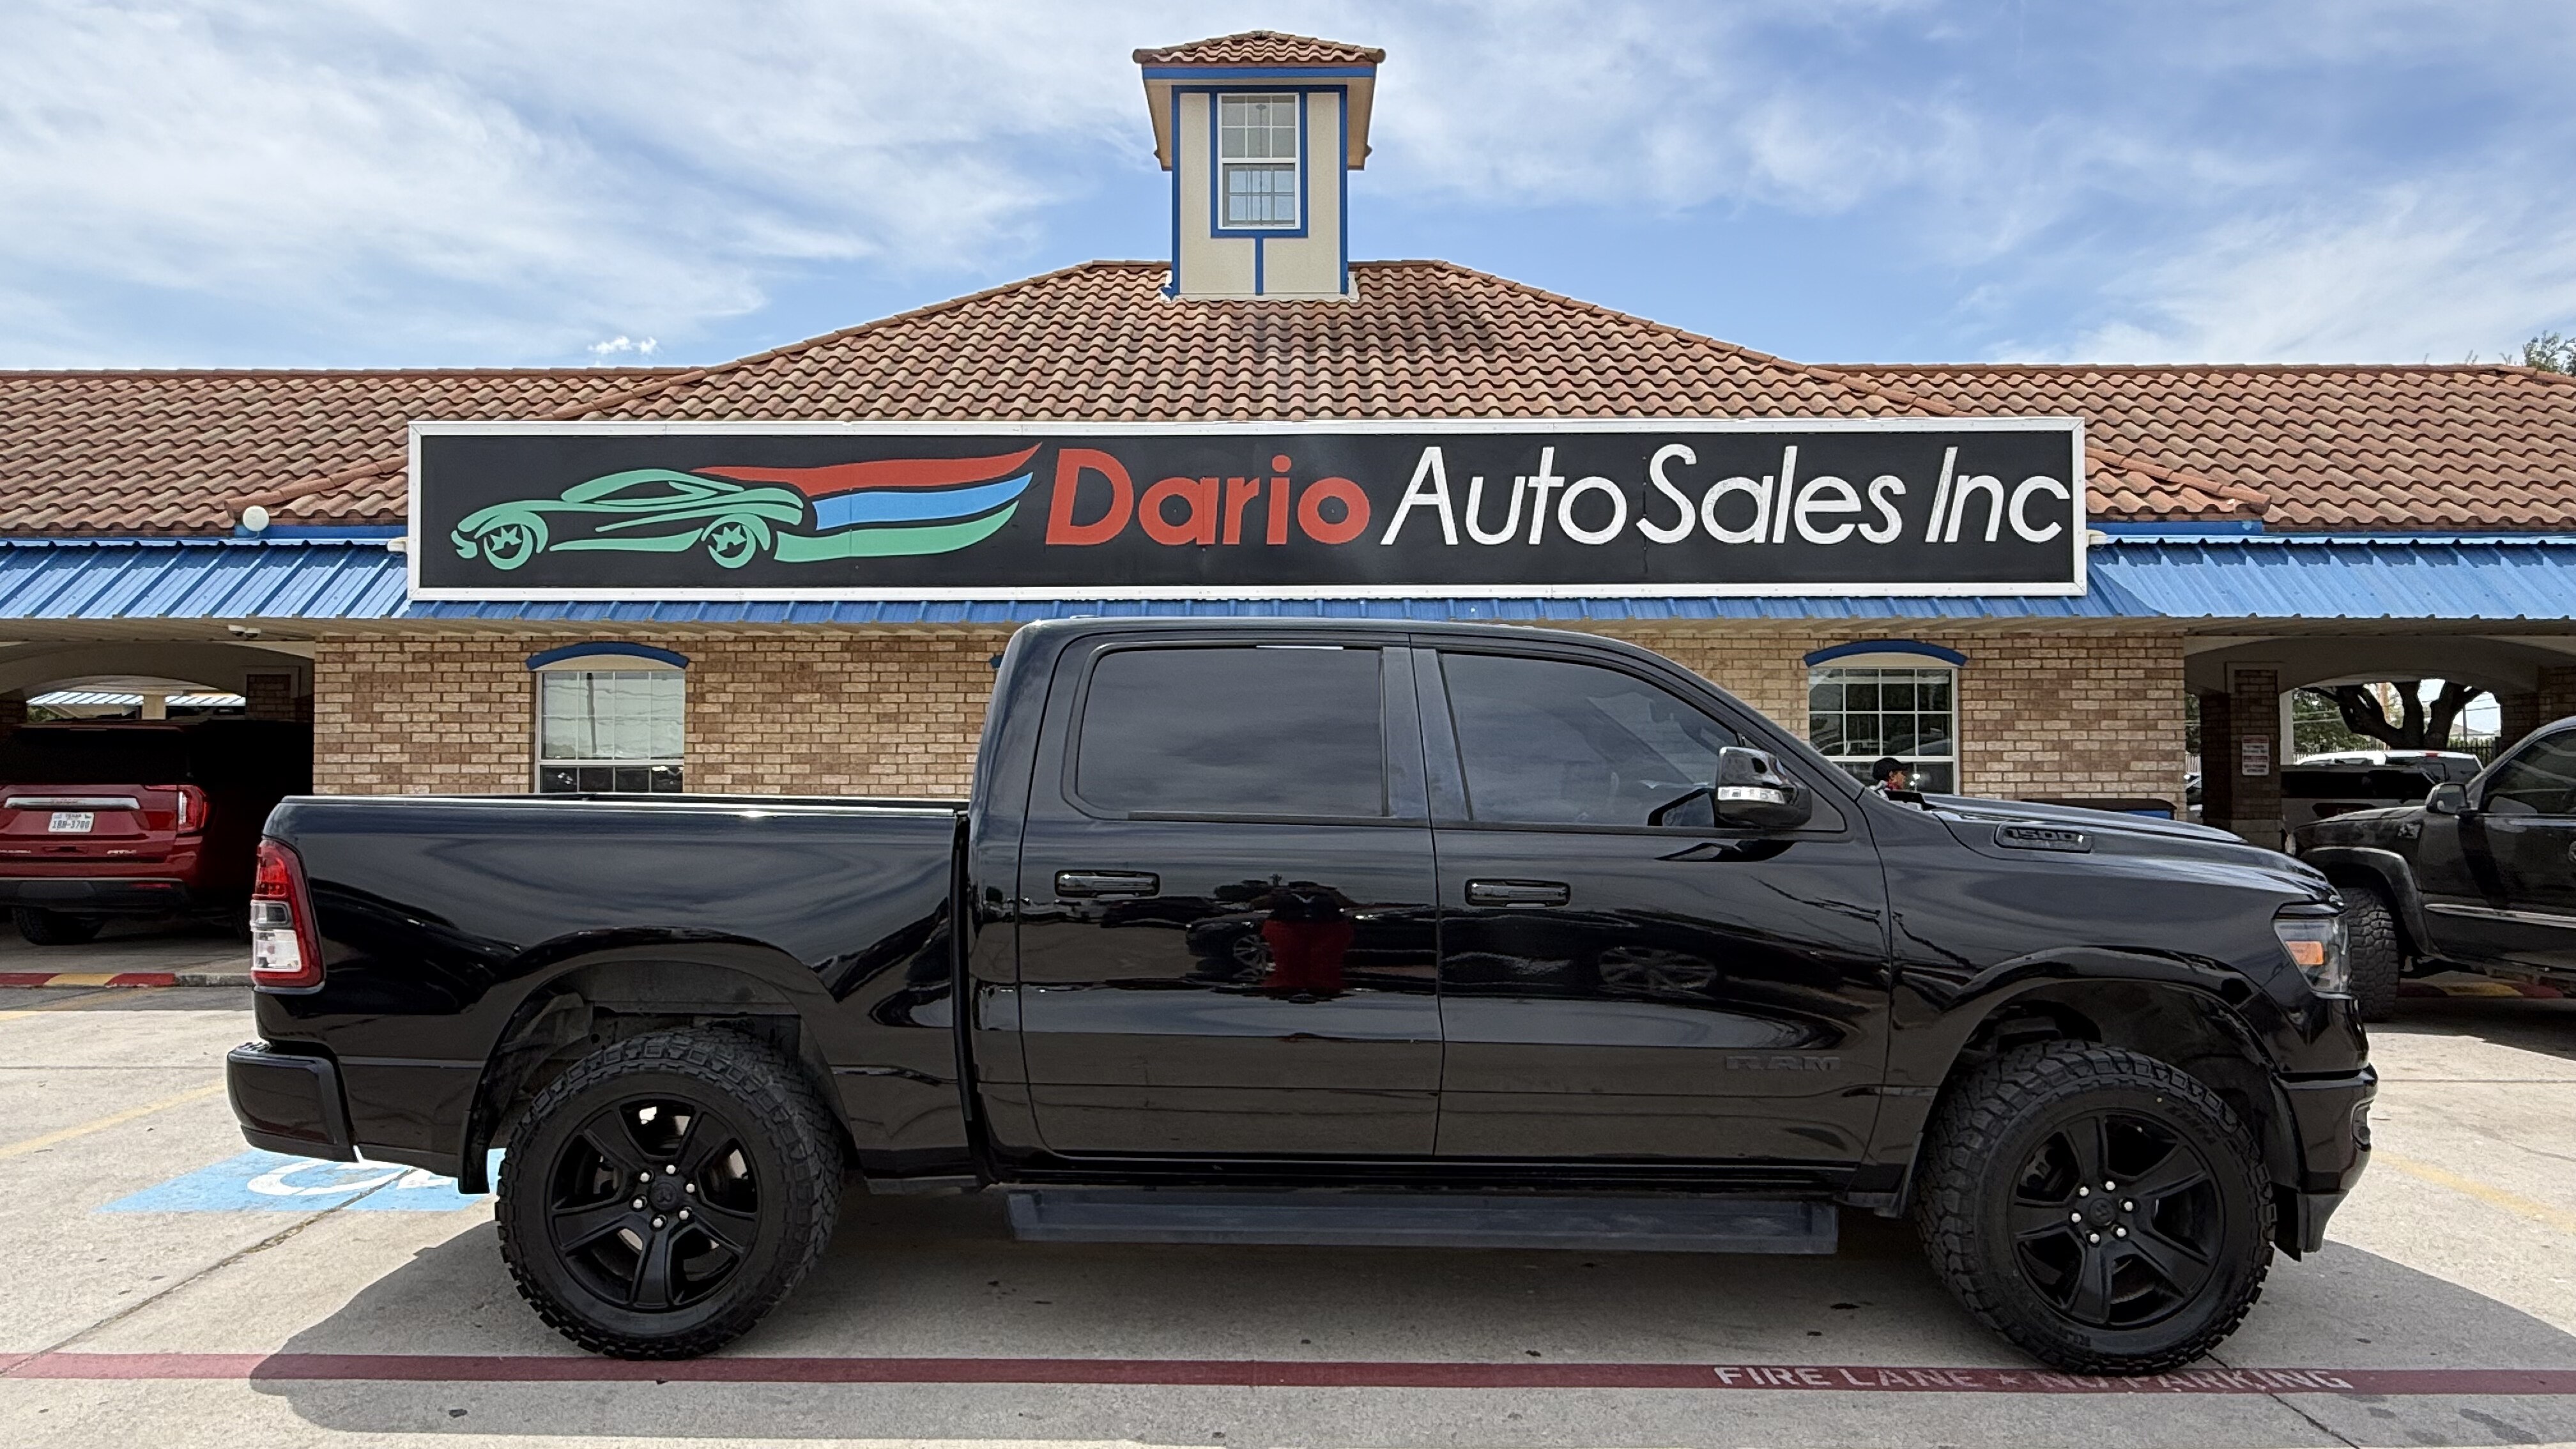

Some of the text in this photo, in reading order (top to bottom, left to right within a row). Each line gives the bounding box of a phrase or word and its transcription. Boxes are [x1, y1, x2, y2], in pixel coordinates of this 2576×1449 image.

[1046, 443, 2070, 545] Dario Auto Sales Inc
[2007, 828, 2076, 841] 1500
[1726, 1056, 1841, 1071] RAM
[1713, 1367, 1832, 1386] FIRE
[1838, 1368, 1985, 1388] LANE
